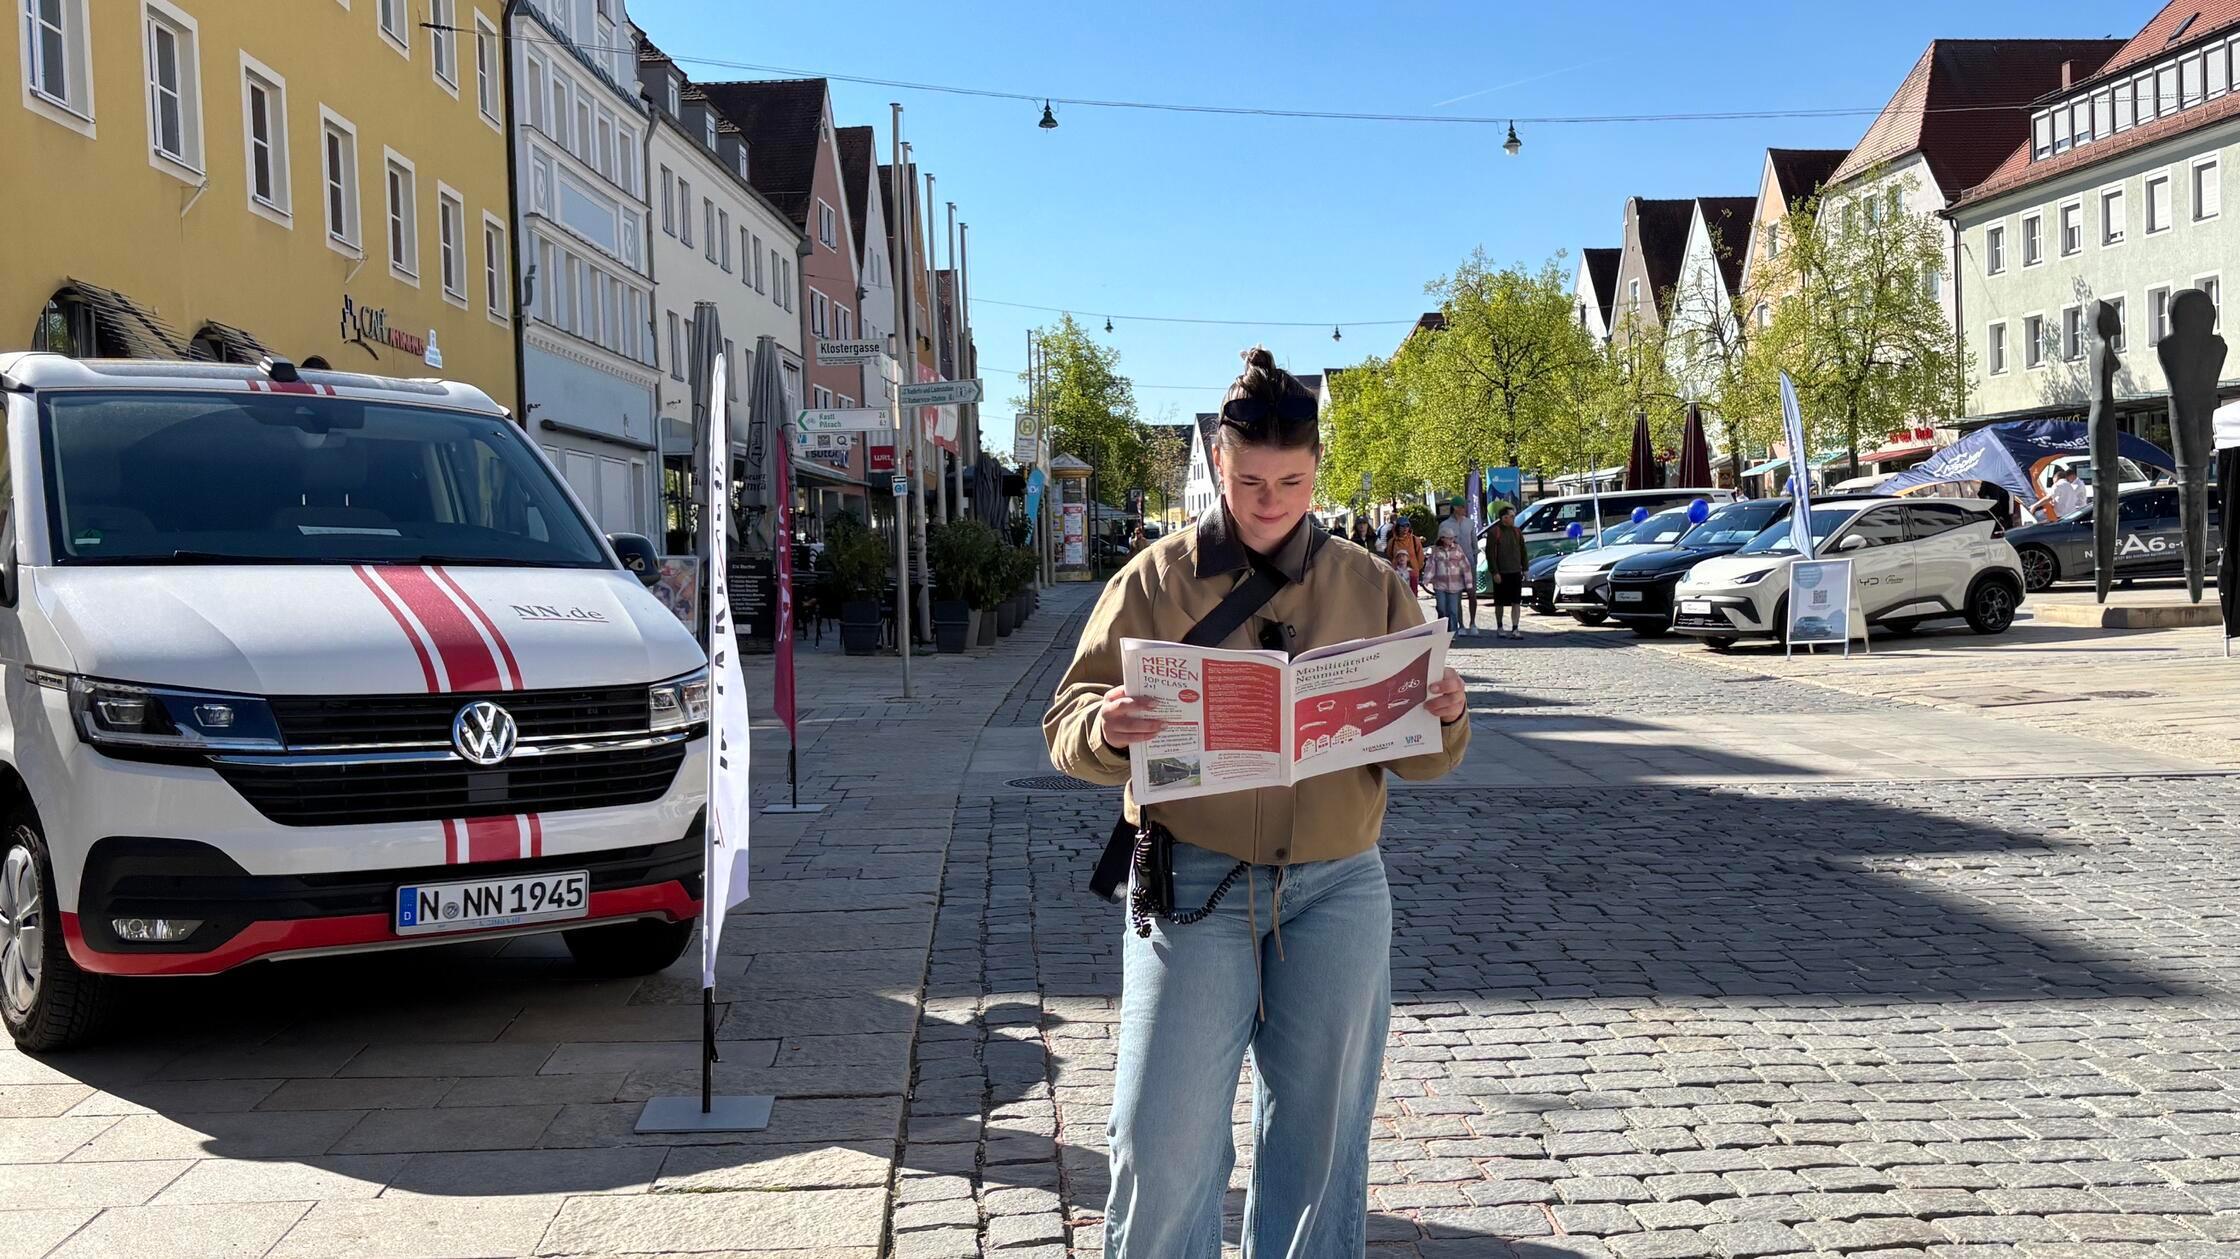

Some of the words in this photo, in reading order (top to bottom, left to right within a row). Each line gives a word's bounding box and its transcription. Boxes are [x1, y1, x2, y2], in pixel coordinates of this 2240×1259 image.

[820, 343, 880, 356] Klostergasse
[819, 420, 842, 429] Pilsach
[2119, 533, 2167, 556] A6
[1859, 577, 1880, 586] YD
[508, 604, 605, 620] NN.de
[1142, 656, 1188, 669] MERZ
[1296, 652, 1380, 677] Mobilitätstag
[1143, 664, 1199, 682] REISEN
[1296, 666, 1358, 685] Neumarkt
[1144, 675, 1160, 684] TOP
[1161, 679, 1188, 689] CLASS
[404, 911, 412, 921] D
[419, 890, 440, 922] N
[463, 885, 503, 918] NN
[510, 877, 584, 914] 1945
